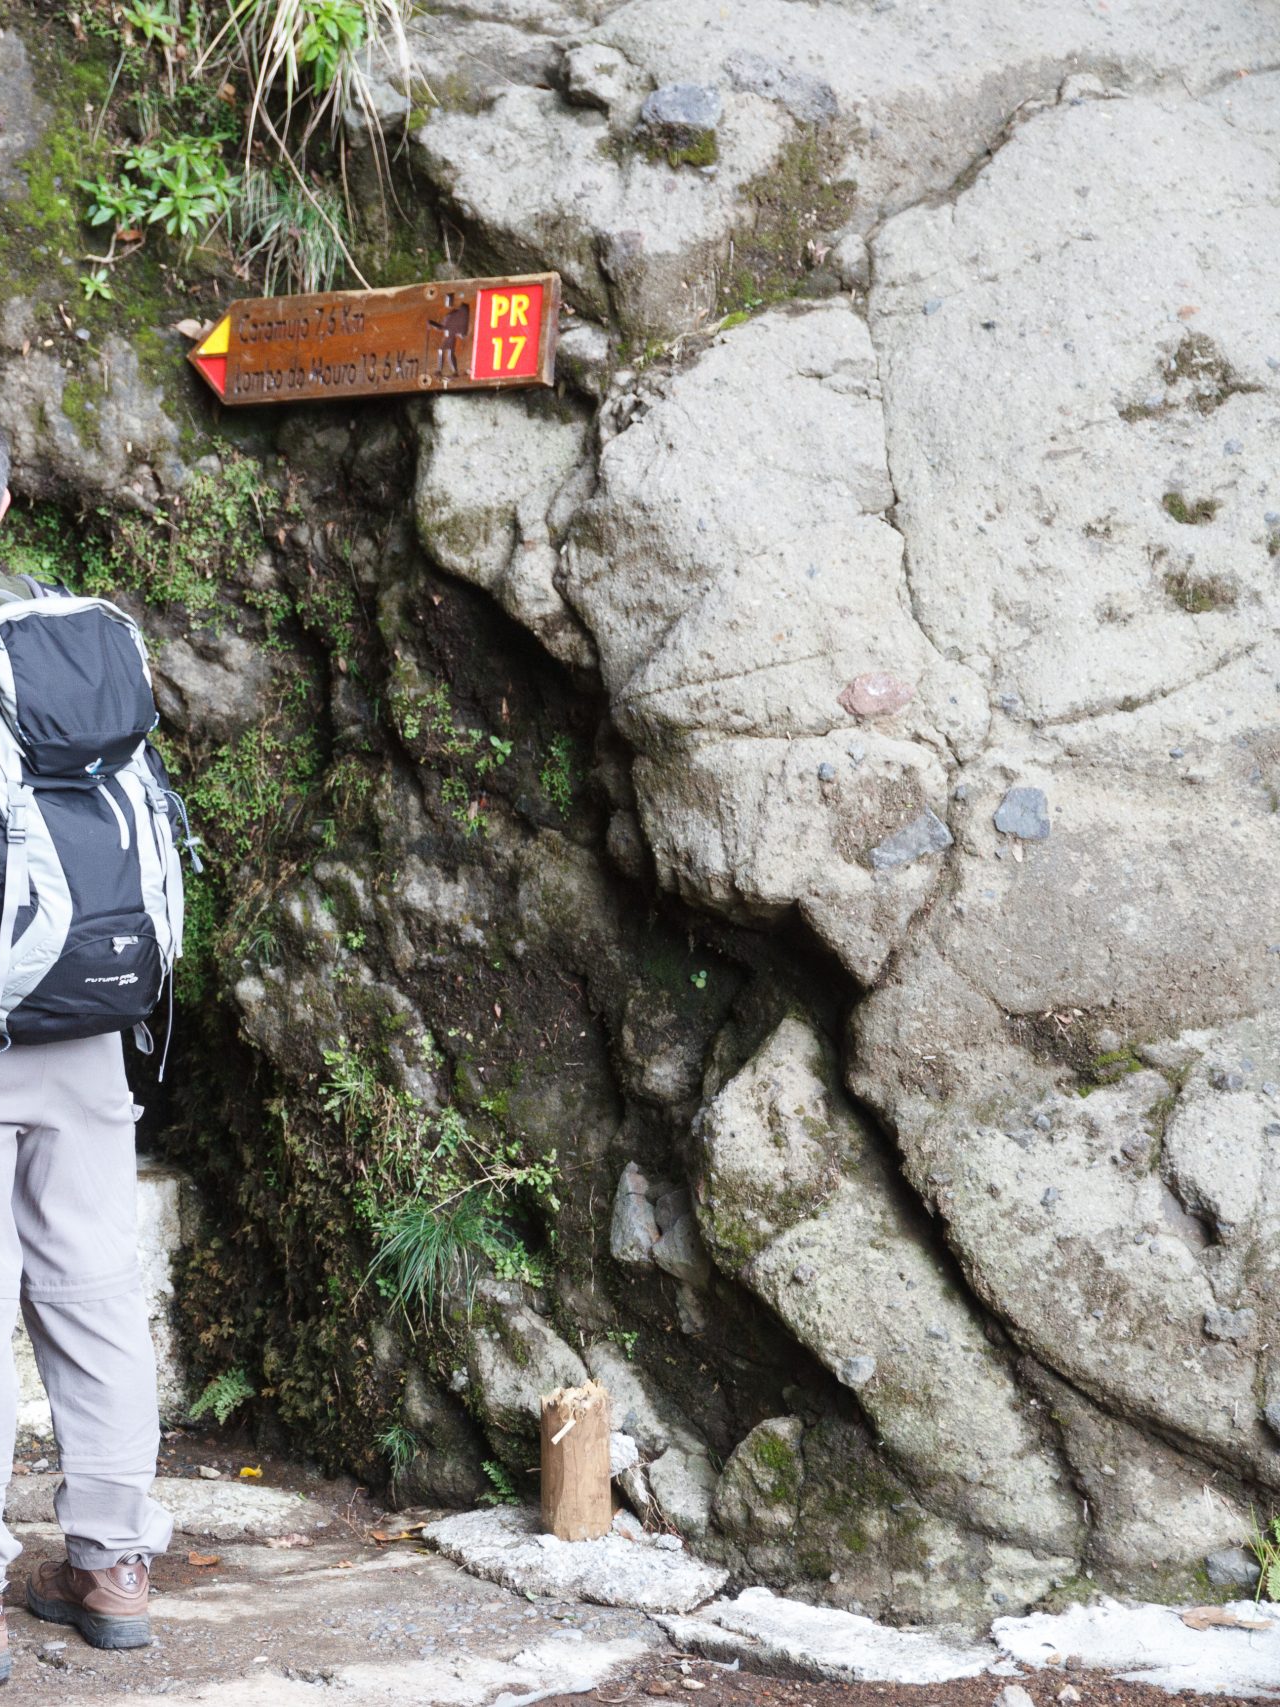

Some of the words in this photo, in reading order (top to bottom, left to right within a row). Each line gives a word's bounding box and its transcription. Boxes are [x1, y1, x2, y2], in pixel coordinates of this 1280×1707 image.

[490, 294, 530, 328] PR
[239, 314, 310, 345] Caramujo
[491, 336, 527, 370] 17
